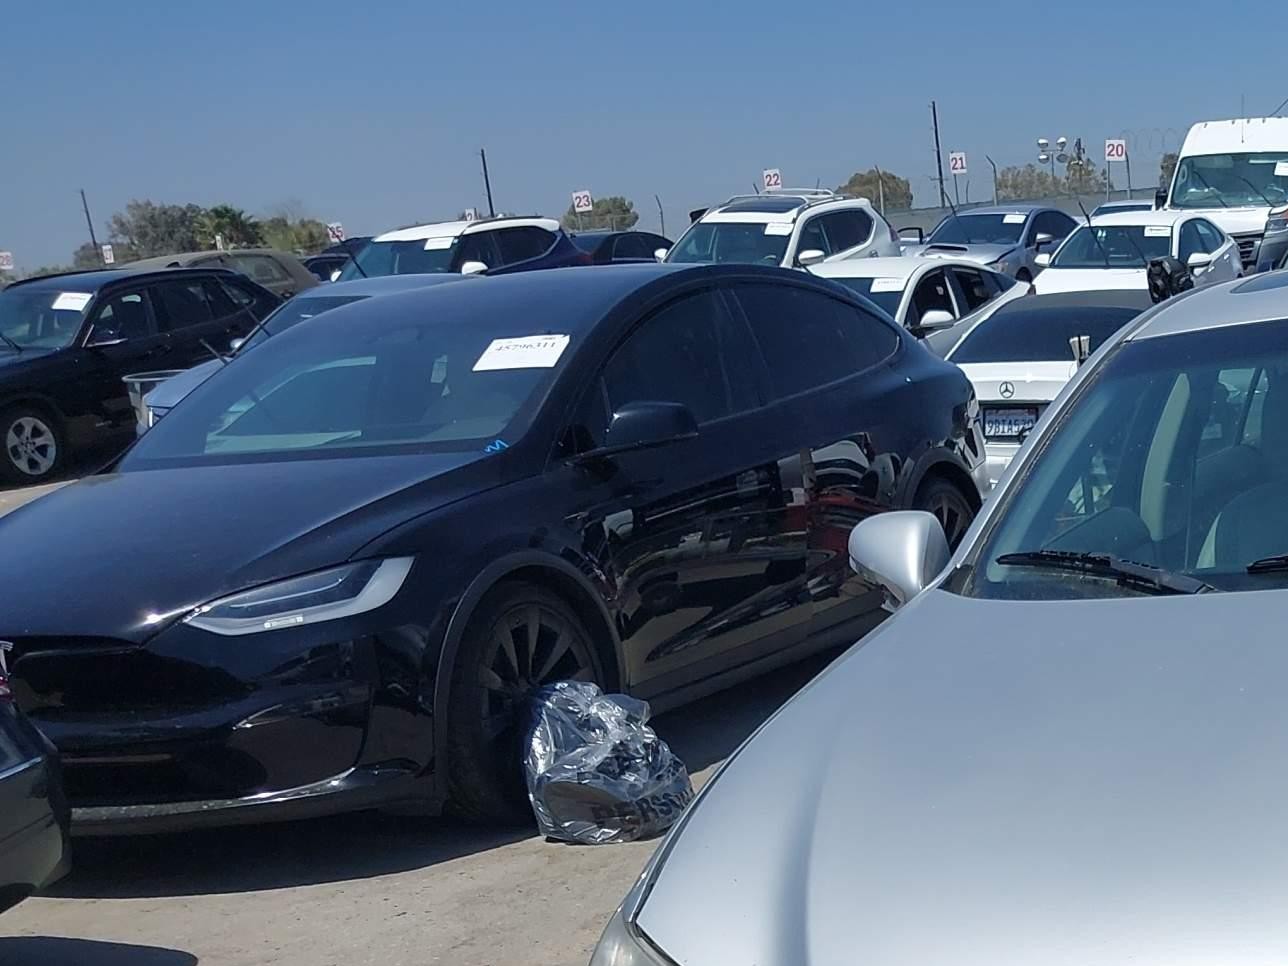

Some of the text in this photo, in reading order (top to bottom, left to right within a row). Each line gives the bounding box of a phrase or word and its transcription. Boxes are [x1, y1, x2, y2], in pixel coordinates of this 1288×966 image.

[1107, 143, 1124, 157] 20
[951, 157, 965, 170] 21
[765, 173, 780, 186] 22
[574, 194, 591, 208] 23
